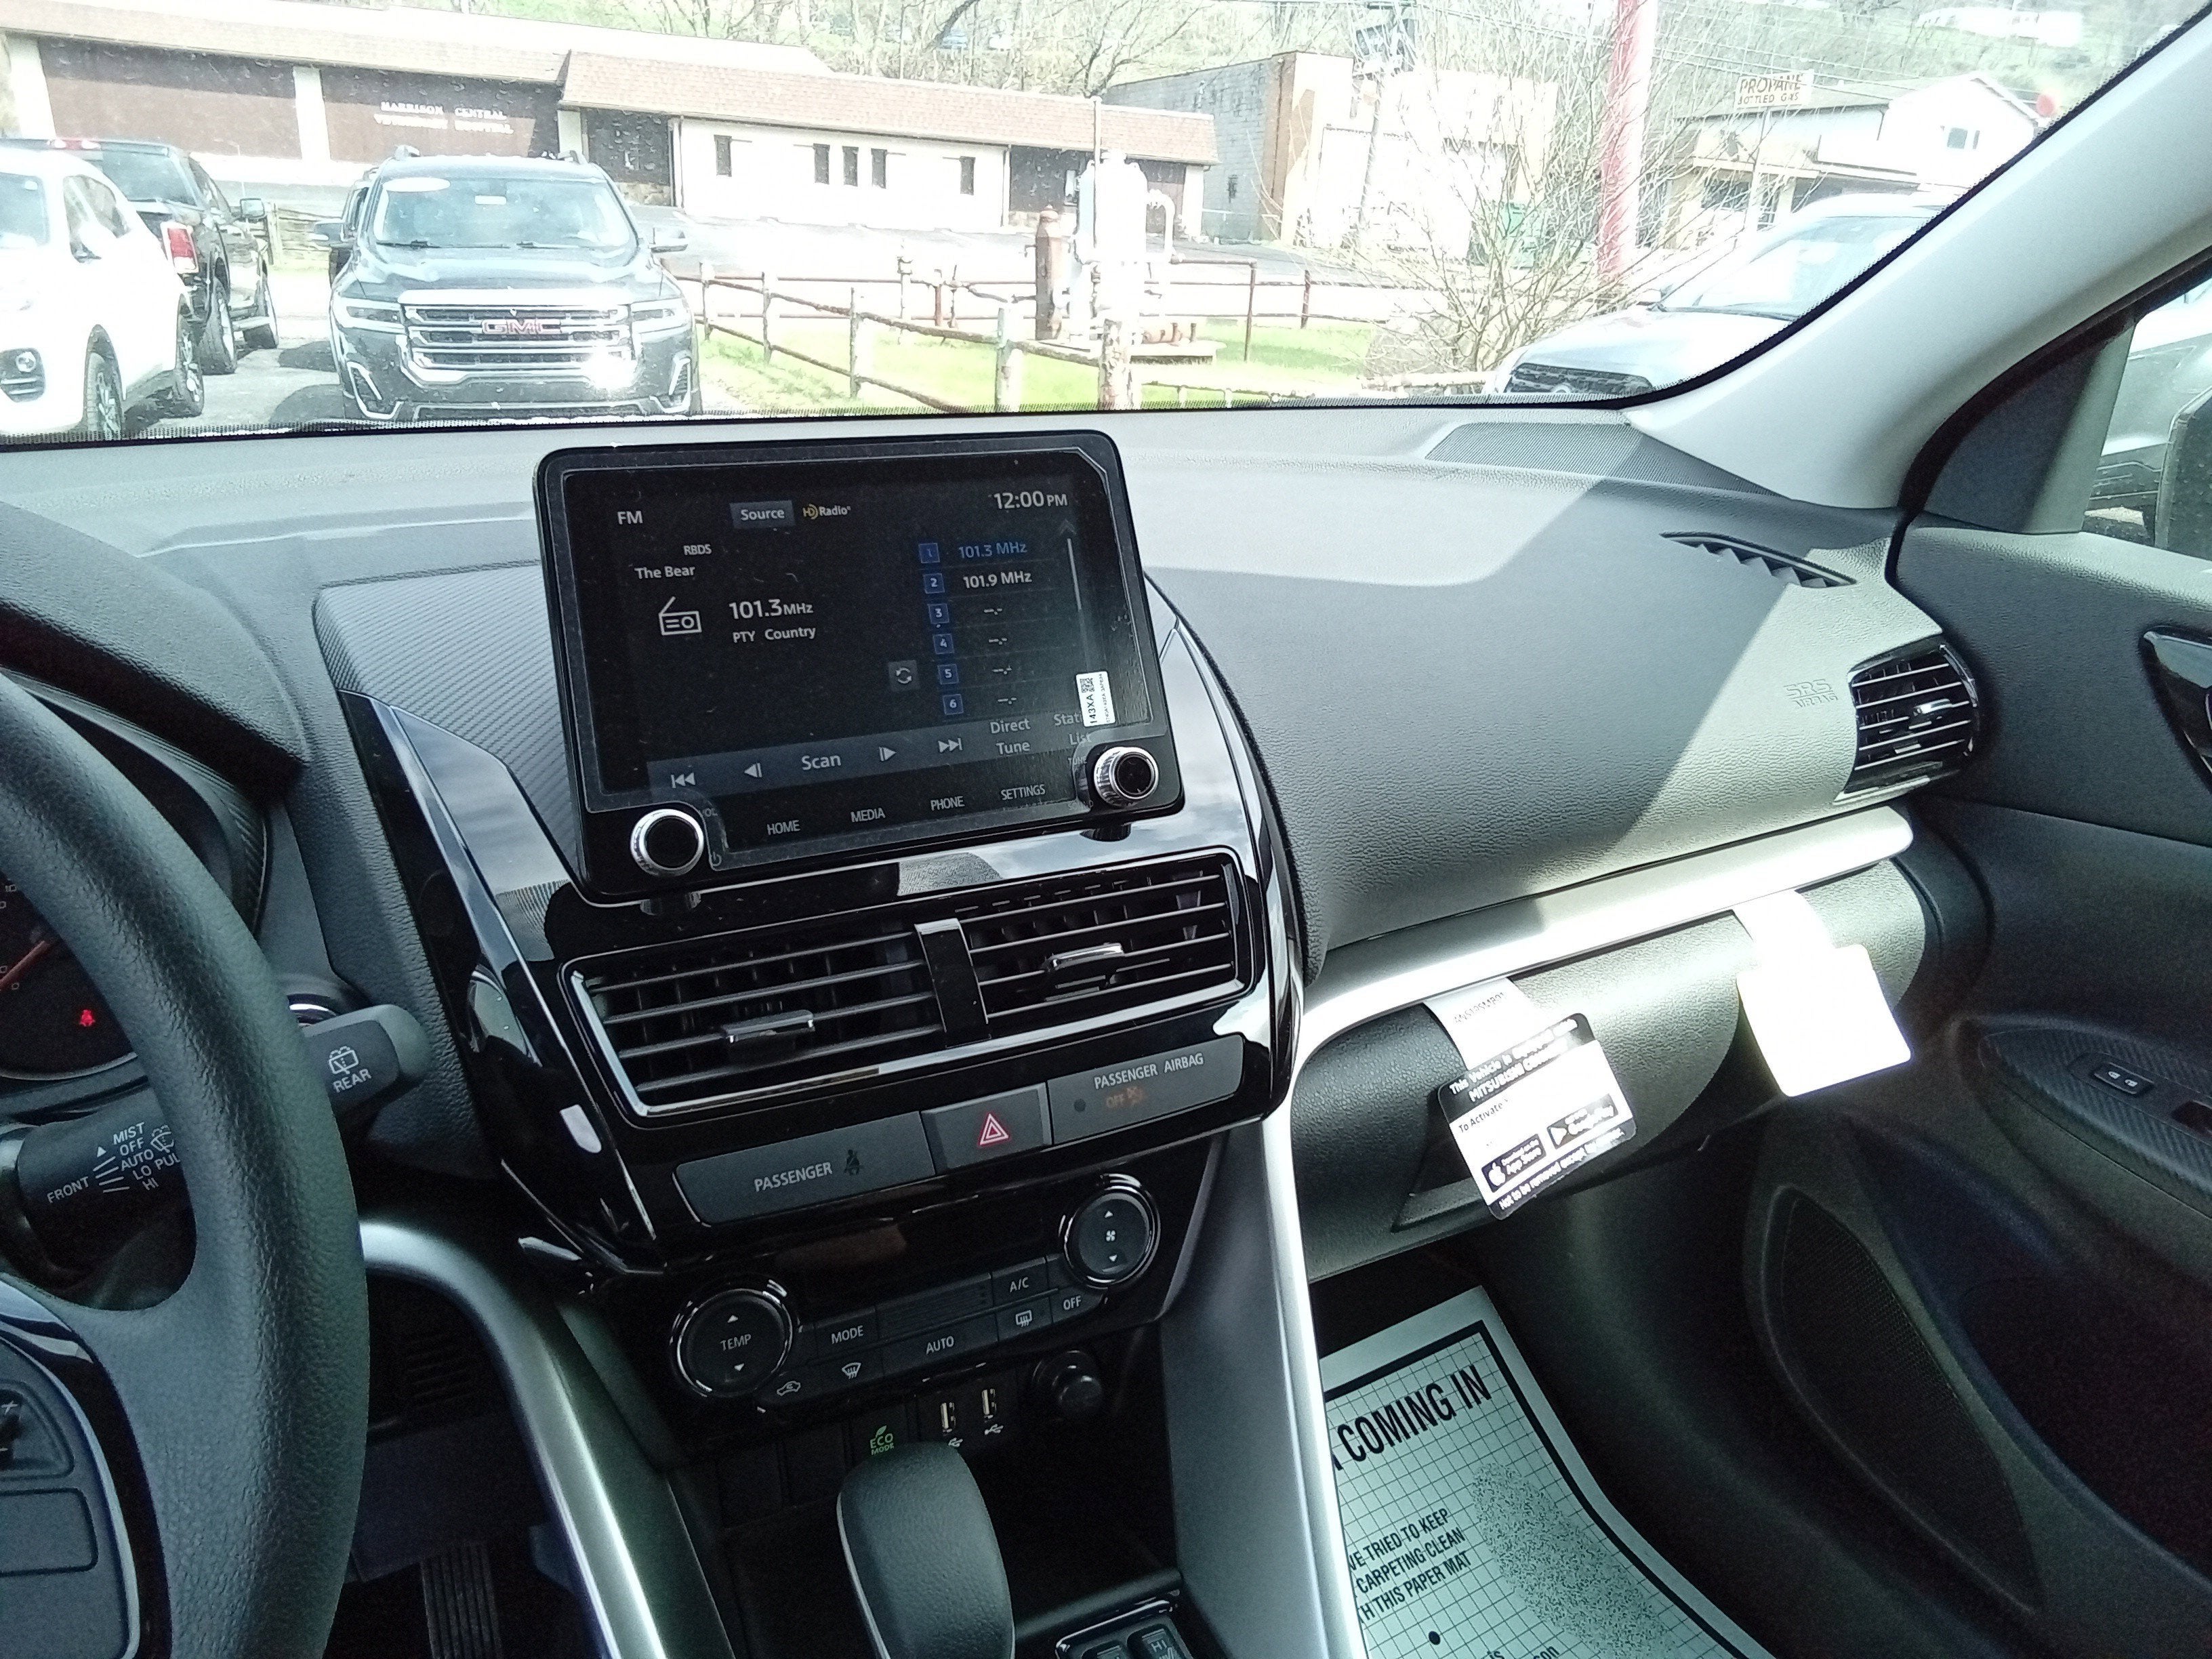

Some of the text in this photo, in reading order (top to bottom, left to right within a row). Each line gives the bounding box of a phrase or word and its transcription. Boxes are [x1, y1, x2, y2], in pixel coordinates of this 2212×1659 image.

[454, 107, 508, 121] CENTRAL
[482, 319, 562, 335] GMC
[617, 510, 643, 525] FM
[740, 508, 785, 521] Source
[684, 544, 712, 556] RBDS
[958, 545, 993, 558] 101.3
[996, 541, 1027, 554] MHz
[634, 565, 695, 579] The Bear
[930, 571, 1033, 588] 2 101.9 MHz
[935, 608, 943, 618] 3
[733, 627, 816, 643] PTY Country
[939, 638, 947, 649] 4
[945, 669, 952, 678] 5
[949, 699, 957, 709] 6
[1086, 693, 1098, 724] 143XA
[990, 718, 1031, 734] Direct
[1054, 711, 1082, 726] Stati
[996, 741, 1031, 756] Tune
[801, 753, 842, 771] Scan
[1000, 784, 1046, 801] SETTINGS
[930, 796, 965, 811] PHONE
[851, 806, 886, 823] MEDIA
[767, 819, 801, 835] HOME
[1094, 1052, 1204, 1090] PASSENGER AIRBAG
[331, 1068, 372, 1093] REAR
[1458, 1101, 1504, 1133] To Activate
[112, 1122, 145, 1145] MIST
[119, 1136, 144, 1156] OFF
[121, 1149, 155, 1172] AUTO
[132, 1164, 152, 1181] LO
[754, 1162, 833, 1192] PASSENGER
[47, 1176, 89, 1204] FRONT
[142, 1177, 159, 1191] HI
[1009, 1276, 1029, 1294] A/C
[1062, 1295, 1082, 1311] OFF
[720, 1333, 752, 1351] TEMP
[831, 1324, 864, 1345] MODE
[926, 1336, 955, 1355] AUTO
[1337, 1364, 1492, 1462] COMING IN
[869, 1433, 894, 1449] ECO
[871, 1442, 895, 1456] MODE
[1363, 1532, 1403, 1561] TRIED
[1400, 1523, 1421, 1543] TO
[1418, 1508, 1450, 1534] KEEP
[1356, 1527, 1467, 1594] CARPETING CLEAN
[1372, 1586, 1406, 1614] THIS
[1403, 1565, 1446, 1598] PAPER
[1443, 1550, 1473, 1577] MAT
